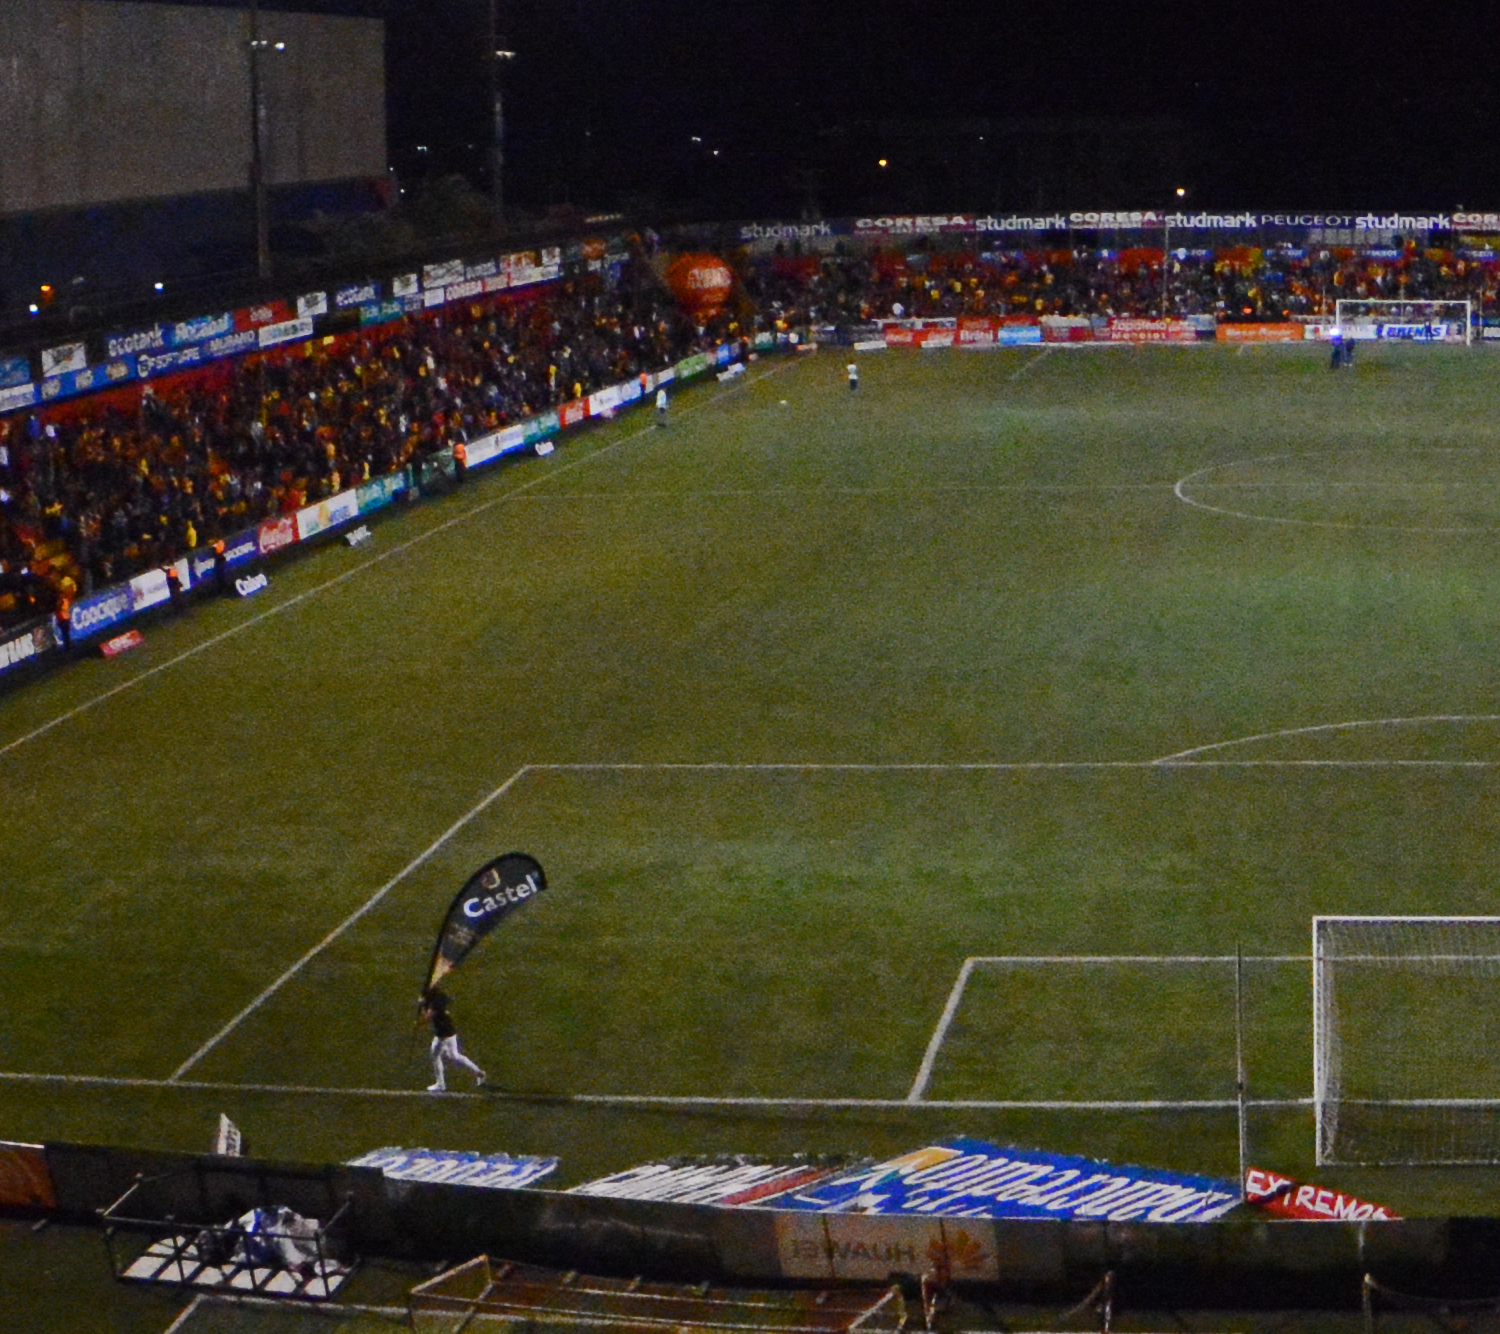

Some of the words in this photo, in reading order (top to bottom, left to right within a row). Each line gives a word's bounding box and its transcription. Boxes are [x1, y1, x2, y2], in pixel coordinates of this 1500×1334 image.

[976, 214, 1066, 231] studmark
[1164, 213, 1257, 229] studmark
[1261, 215, 1352, 227] PEUGEOT
[1355, 213, 1450, 230] studmark
[463, 874, 538, 919] Castel
